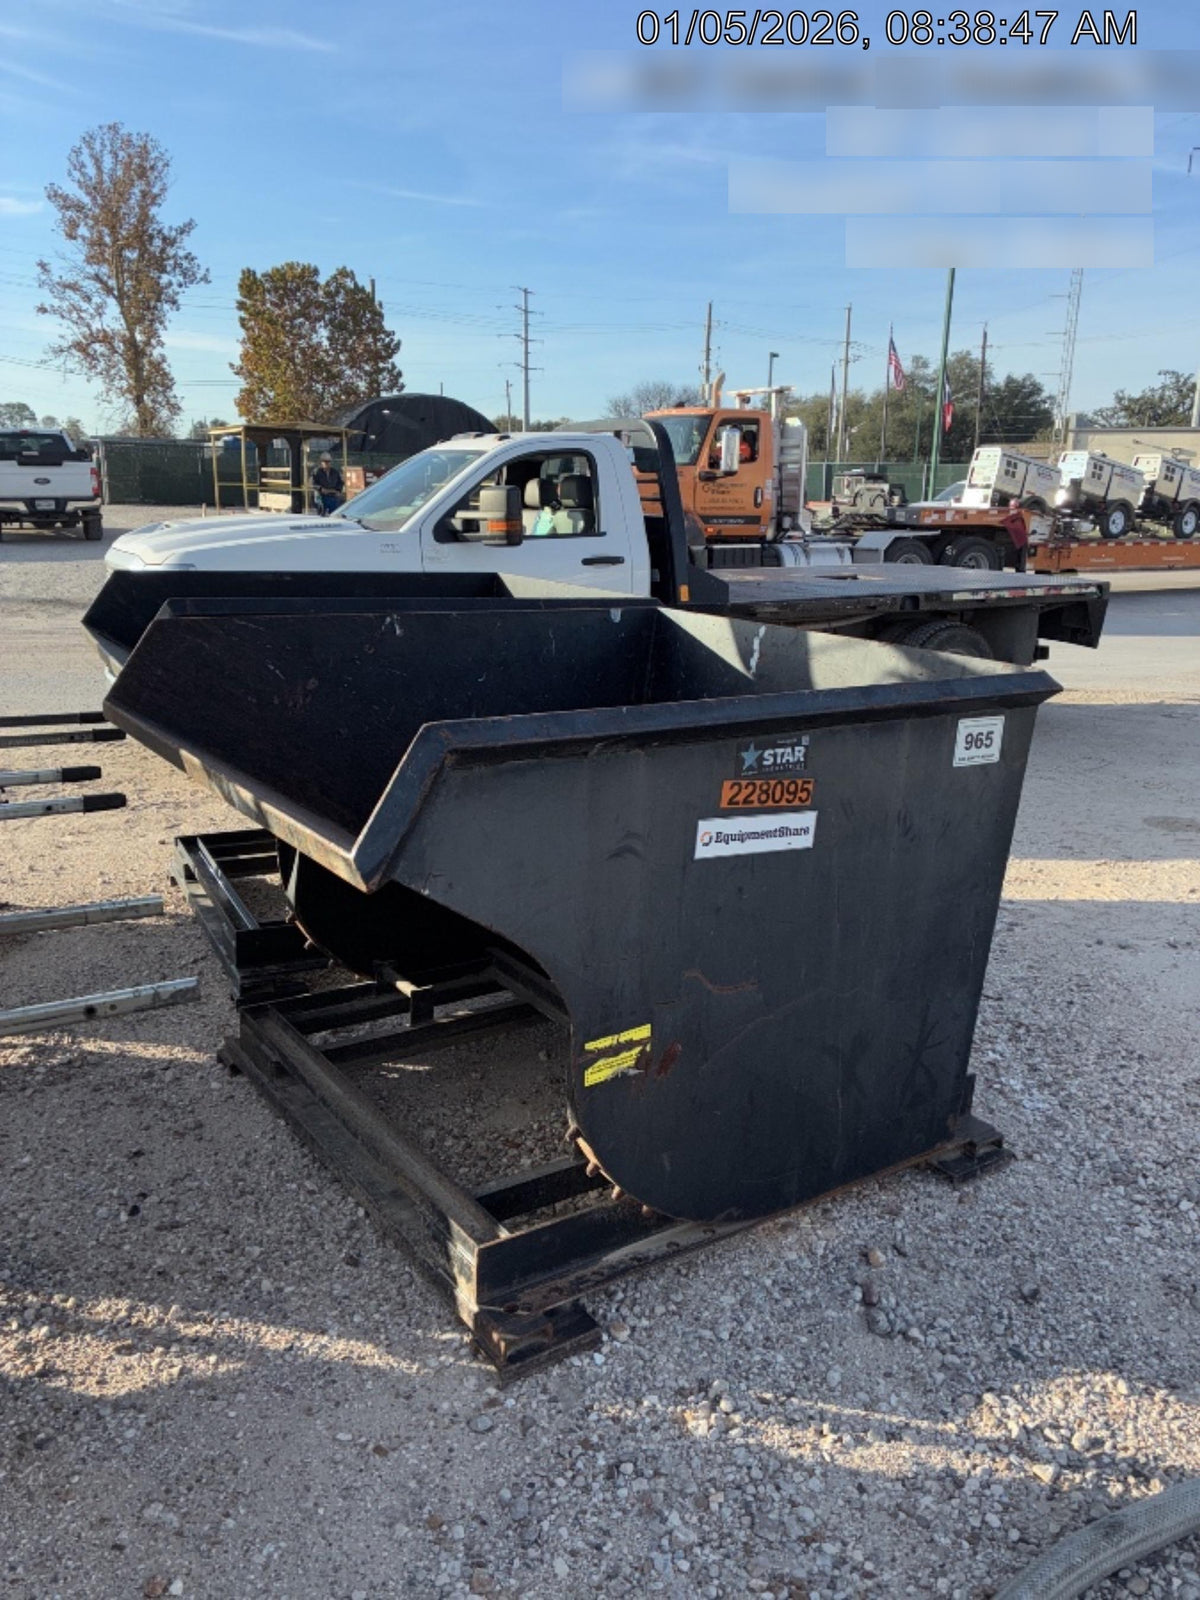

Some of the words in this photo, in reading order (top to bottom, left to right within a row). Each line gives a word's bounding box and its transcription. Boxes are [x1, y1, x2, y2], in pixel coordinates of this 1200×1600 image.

[964, 730, 995, 751] 965
[762, 746, 806, 766] STAR
[726, 780, 812, 806] 228095
[714, 826, 810, 845] EquipmentShare
